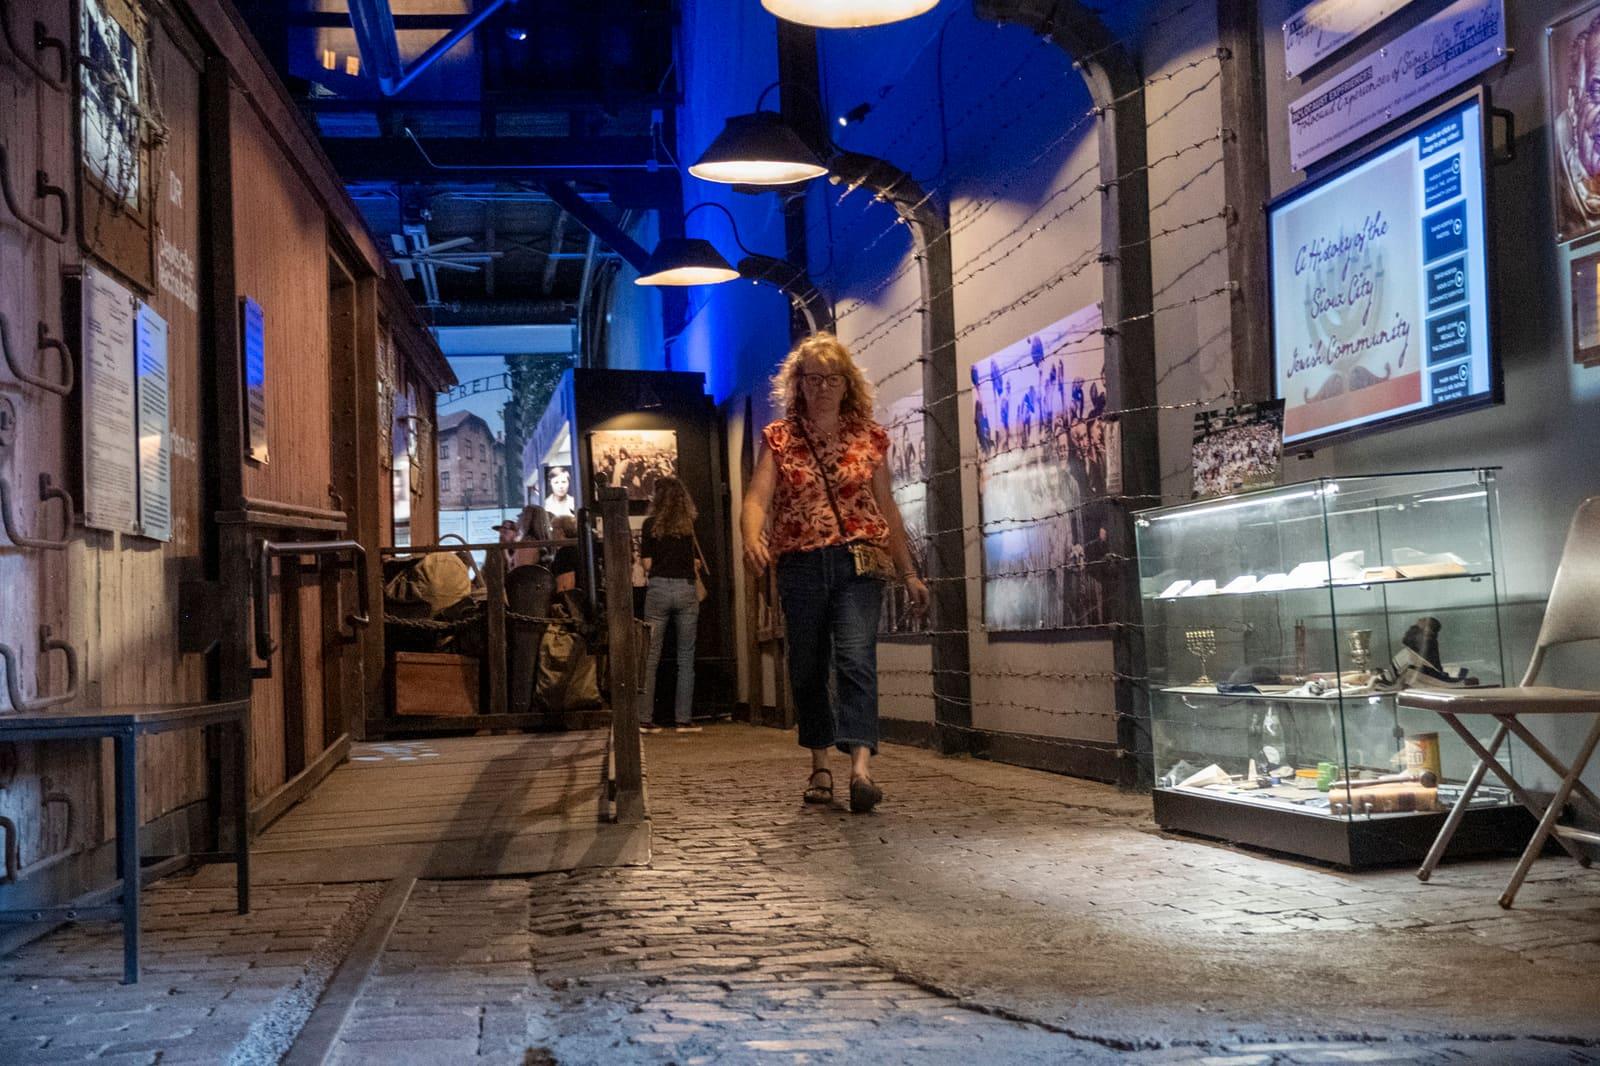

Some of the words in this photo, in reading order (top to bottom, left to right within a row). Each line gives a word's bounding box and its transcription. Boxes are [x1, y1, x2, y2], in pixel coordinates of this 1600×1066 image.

[1368, 210, 1388, 241] the
[1311, 287, 1345, 319] Sioux
[1348, 272, 1374, 326] City
[1287, 339, 1326, 378] Jewish
[1326, 312, 1410, 369] Community
